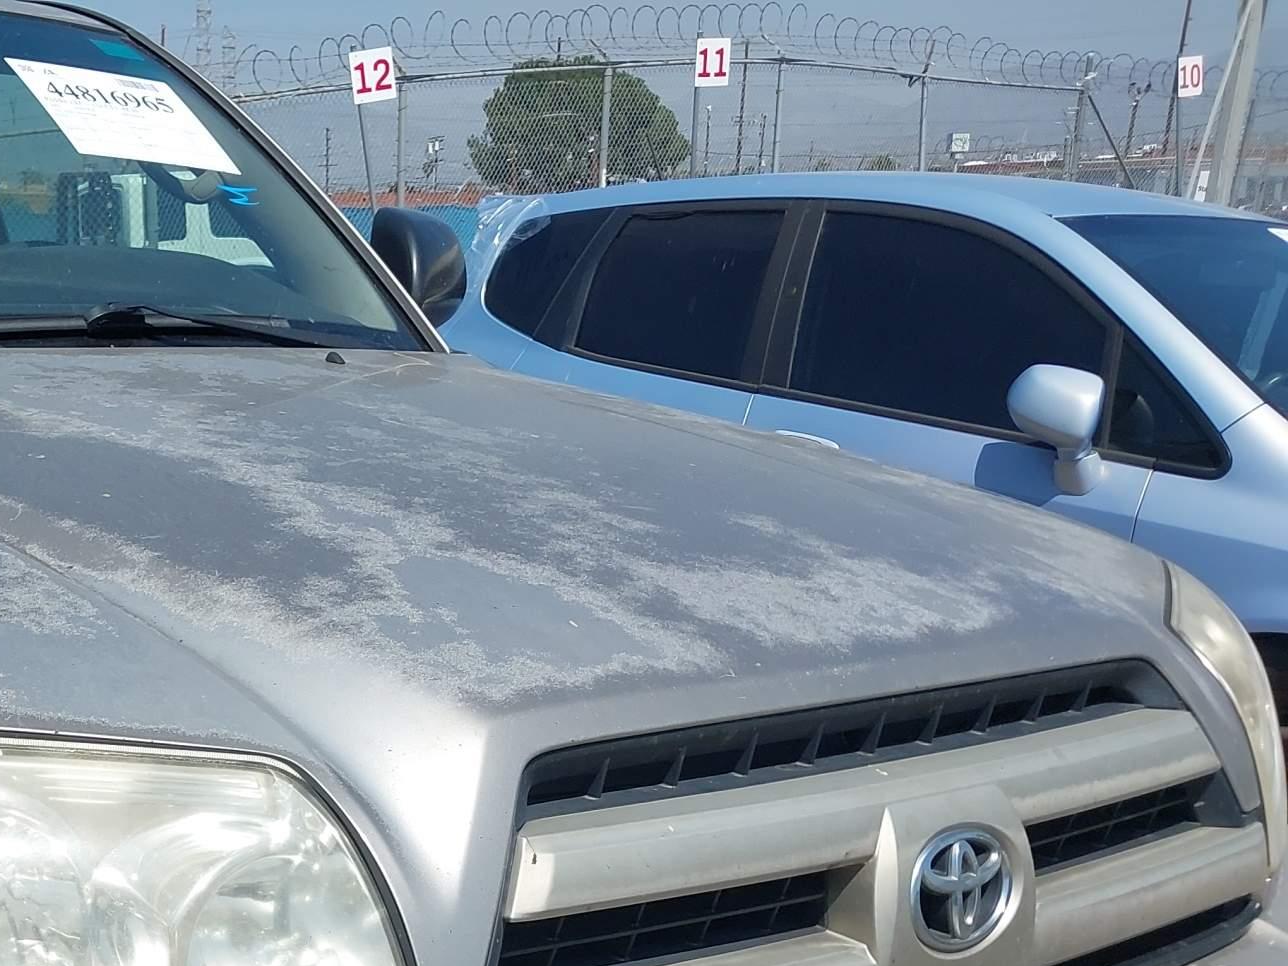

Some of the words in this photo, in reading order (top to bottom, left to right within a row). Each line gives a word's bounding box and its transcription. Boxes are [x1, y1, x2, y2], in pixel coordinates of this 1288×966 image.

[354, 58, 392, 94] 12
[698, 47, 726, 77] 11
[1179, 64, 1201, 89] 10
[46, 81, 175, 114] 44816965
